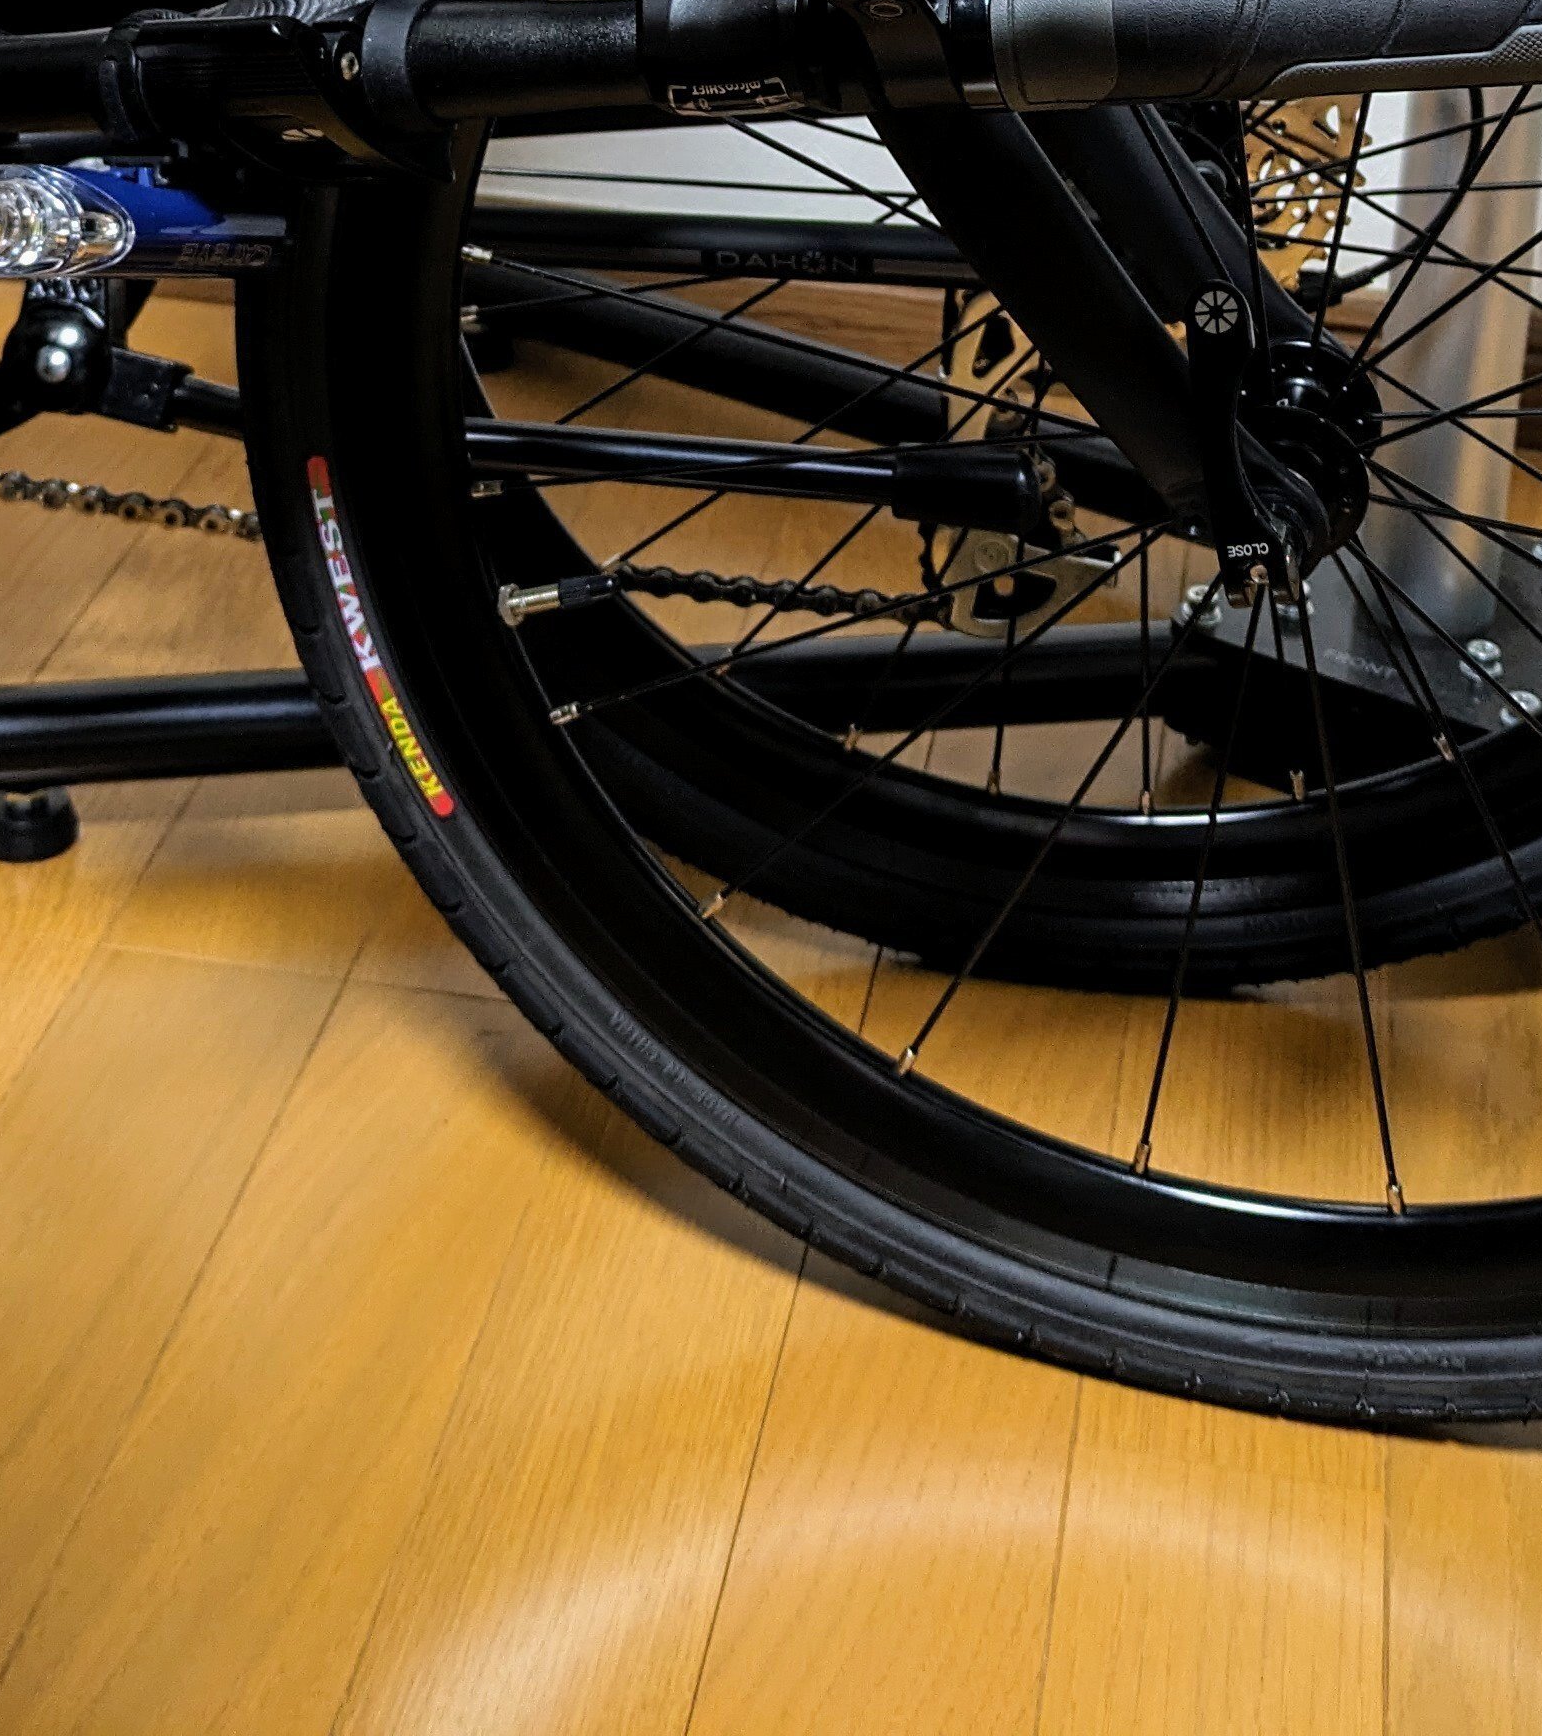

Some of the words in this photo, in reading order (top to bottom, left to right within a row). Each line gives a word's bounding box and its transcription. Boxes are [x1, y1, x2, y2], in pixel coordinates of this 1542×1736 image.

[692, 79, 762, 96] microSHIFT
[716, 251, 858, 274] DAHON
[1227, 542, 1268, 558] CLOSE
[310, 487, 382, 672] KWEST
[379, 696, 444, 799] KENDA
